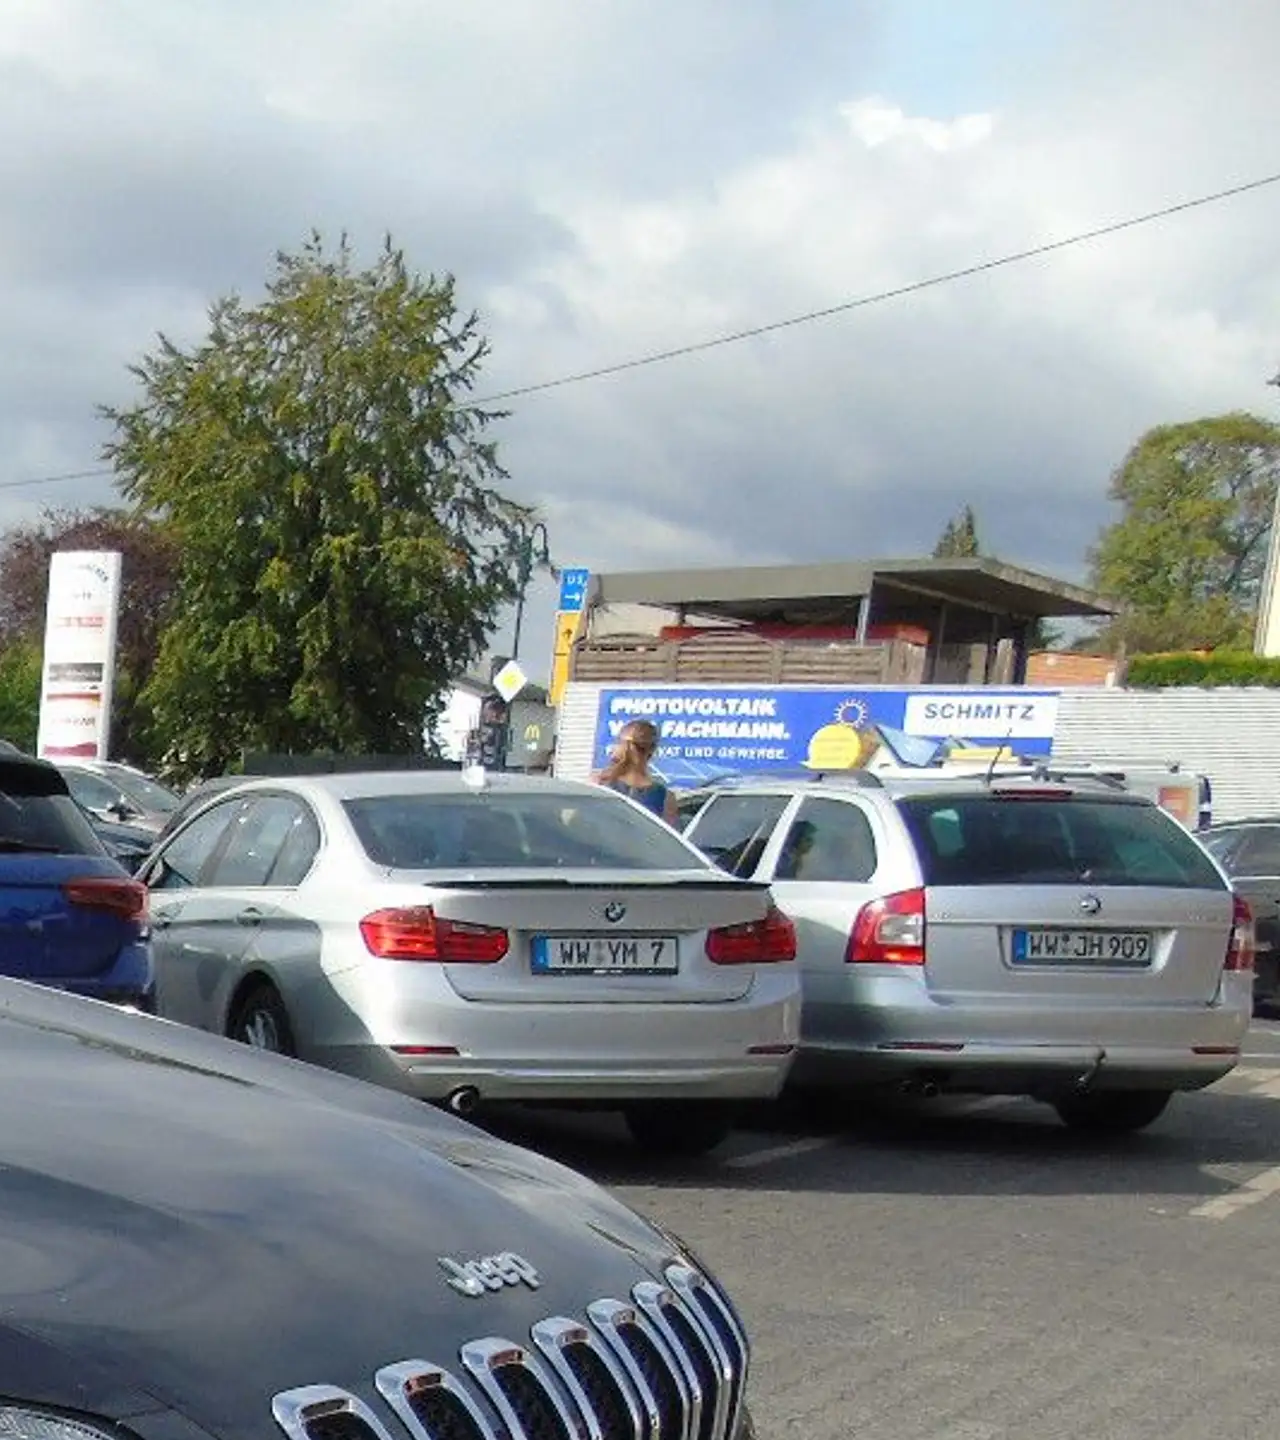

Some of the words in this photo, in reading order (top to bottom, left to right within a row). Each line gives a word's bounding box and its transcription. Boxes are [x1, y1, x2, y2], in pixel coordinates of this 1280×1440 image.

[610, 697, 776, 717] PHOTOVOLTAIK
[924, 703, 1034, 720] SCHMITZ
[684, 746, 714, 758] UND
[608, 941, 638, 965] YM
[651, 941, 665, 965] 7
[1109, 936, 1148, 959] 909
[437, 1251, 541, 1297] Jeep
